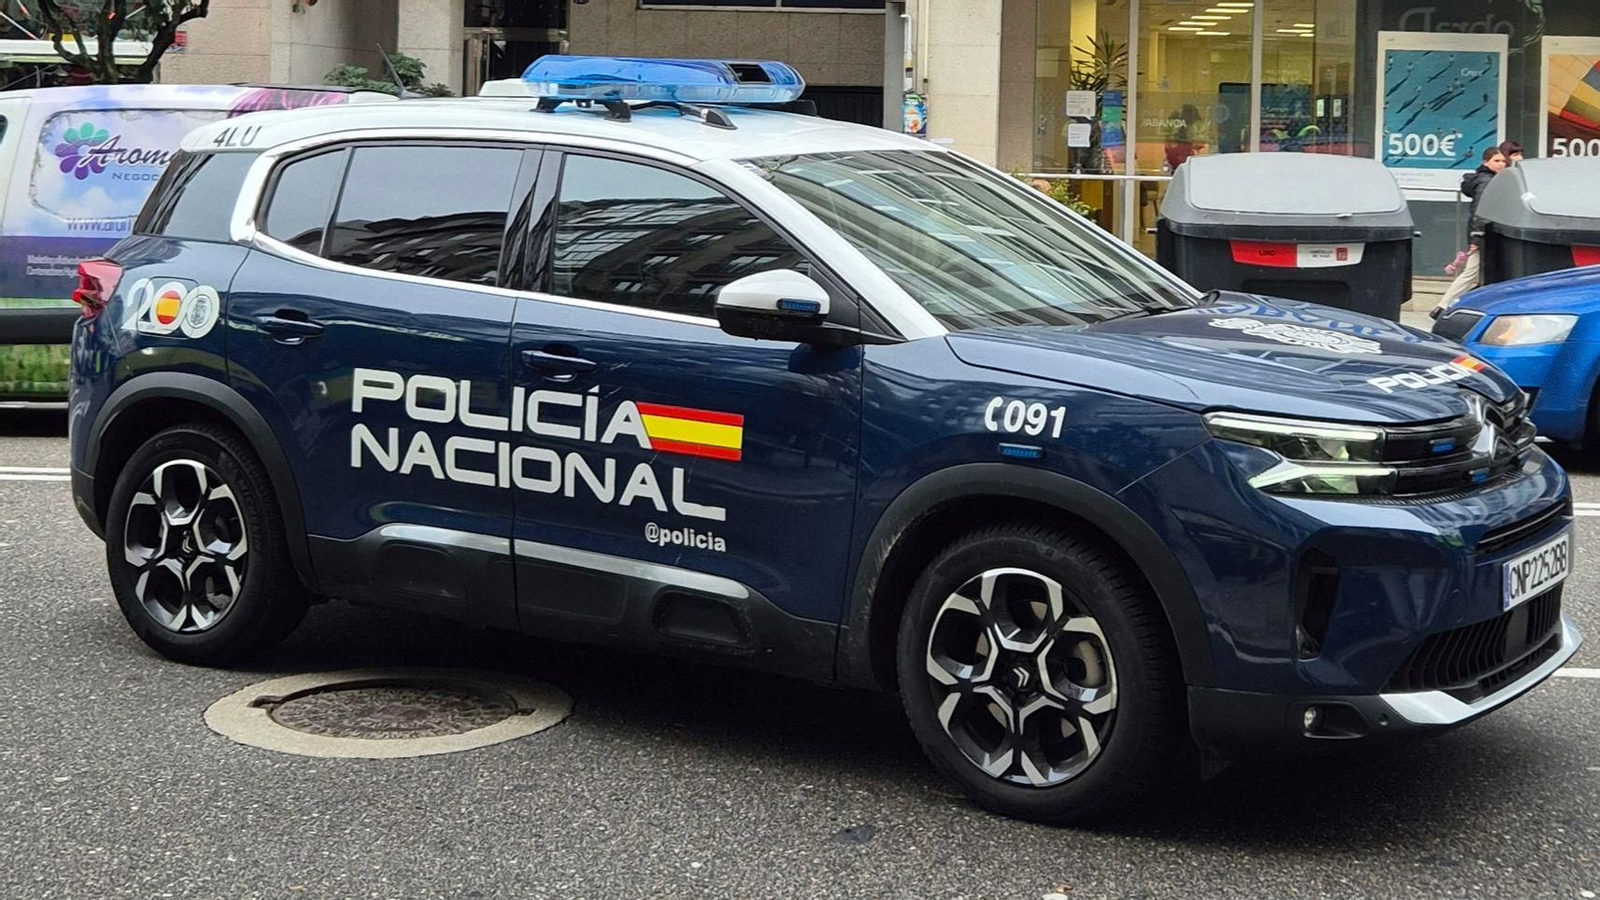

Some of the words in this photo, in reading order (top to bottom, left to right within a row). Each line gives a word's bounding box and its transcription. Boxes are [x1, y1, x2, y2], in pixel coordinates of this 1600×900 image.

[213, 125, 262, 147] 4LU
[121, 278, 220, 339] 200
[351, 367, 652, 450] POLICÍA
[351, 423, 726, 521] NACIONAL
[644, 522, 726, 552] @policia
